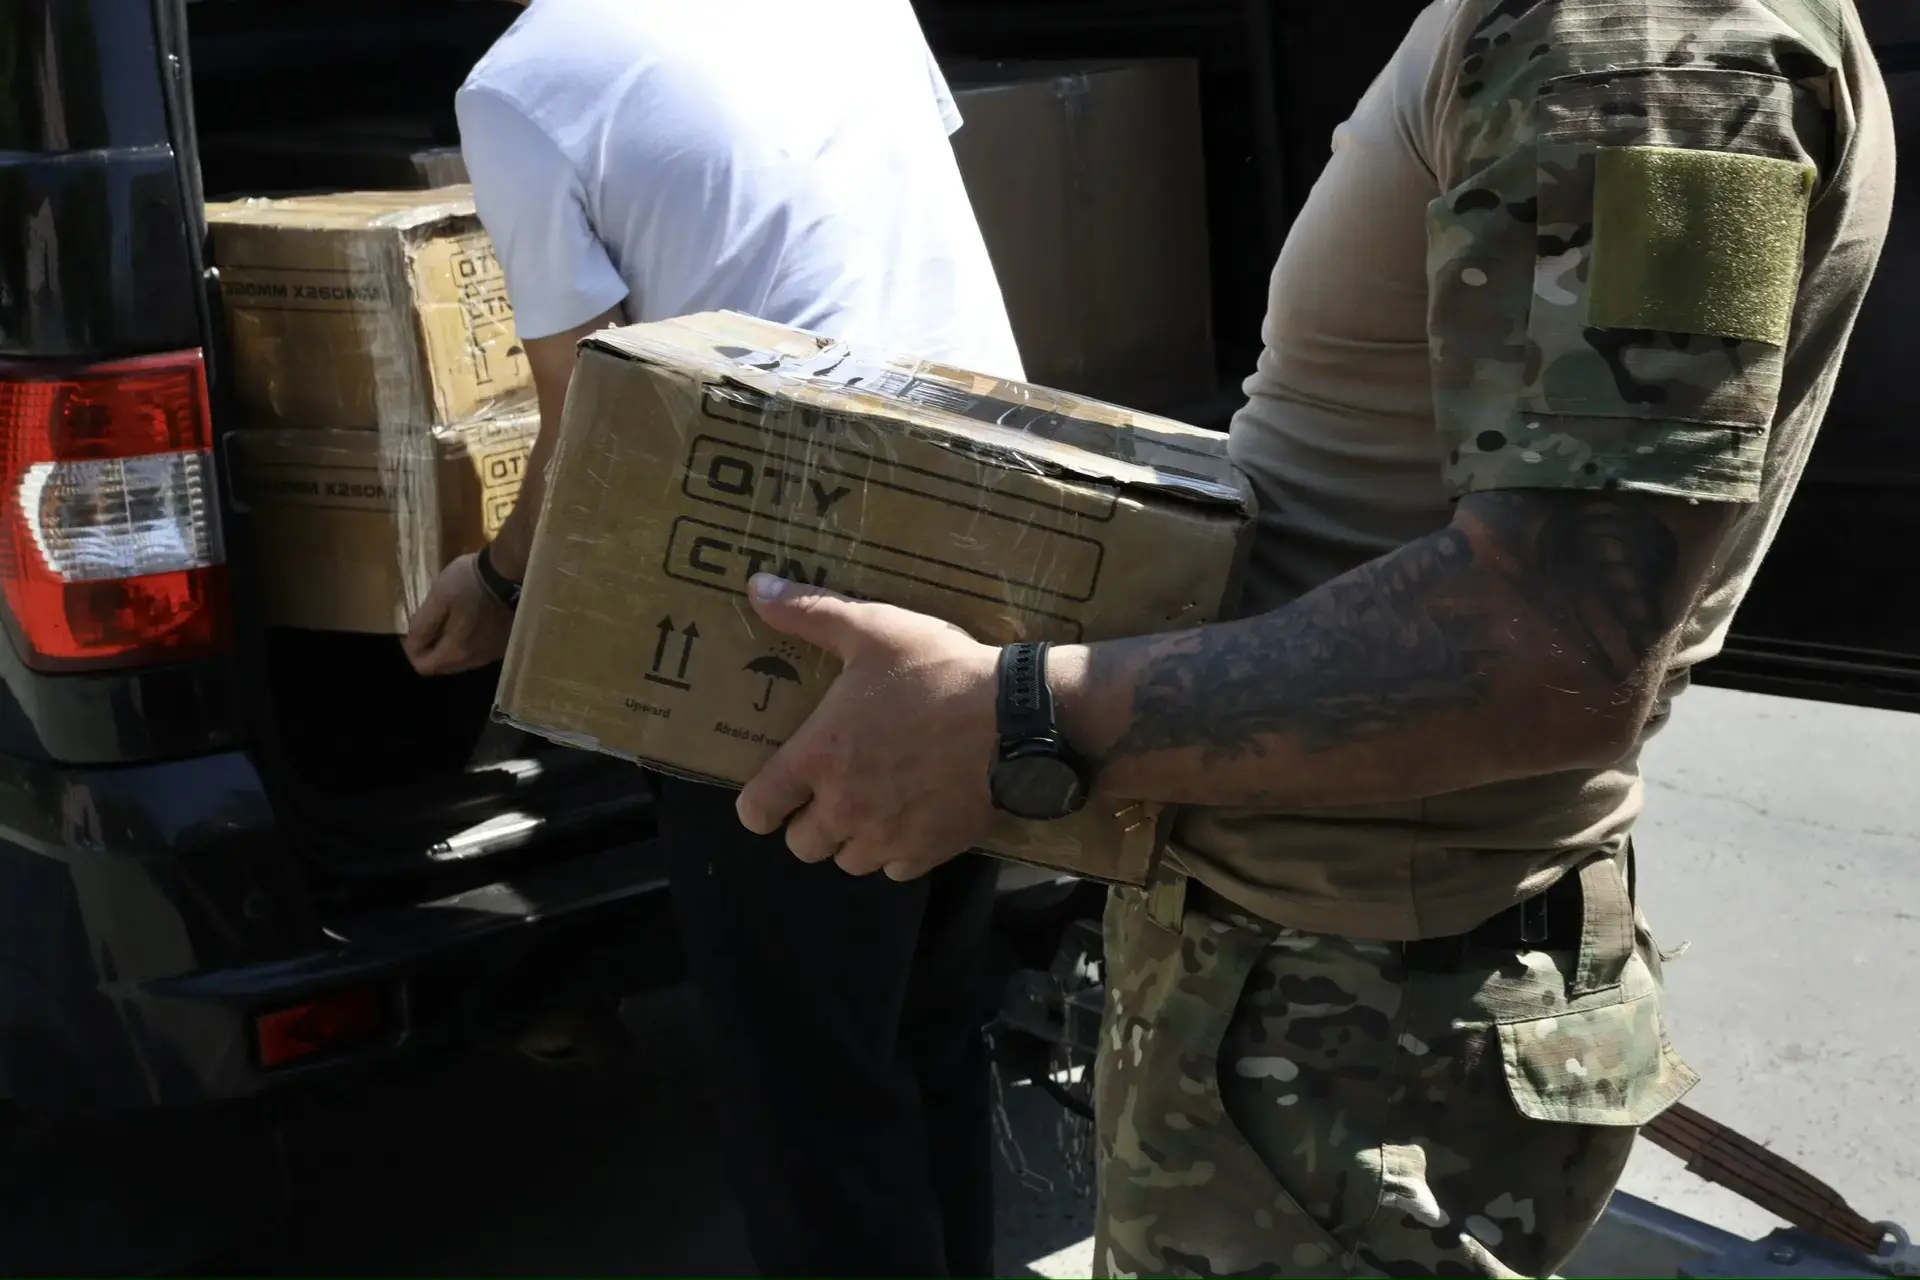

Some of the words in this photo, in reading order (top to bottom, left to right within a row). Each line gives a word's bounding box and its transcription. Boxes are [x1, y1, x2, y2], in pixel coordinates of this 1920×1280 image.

[708, 455, 852, 517] QTY
[625, 697, 672, 719] Upward
[714, 721, 749, 740] Afraid
[751, 733, 765, 744] of
